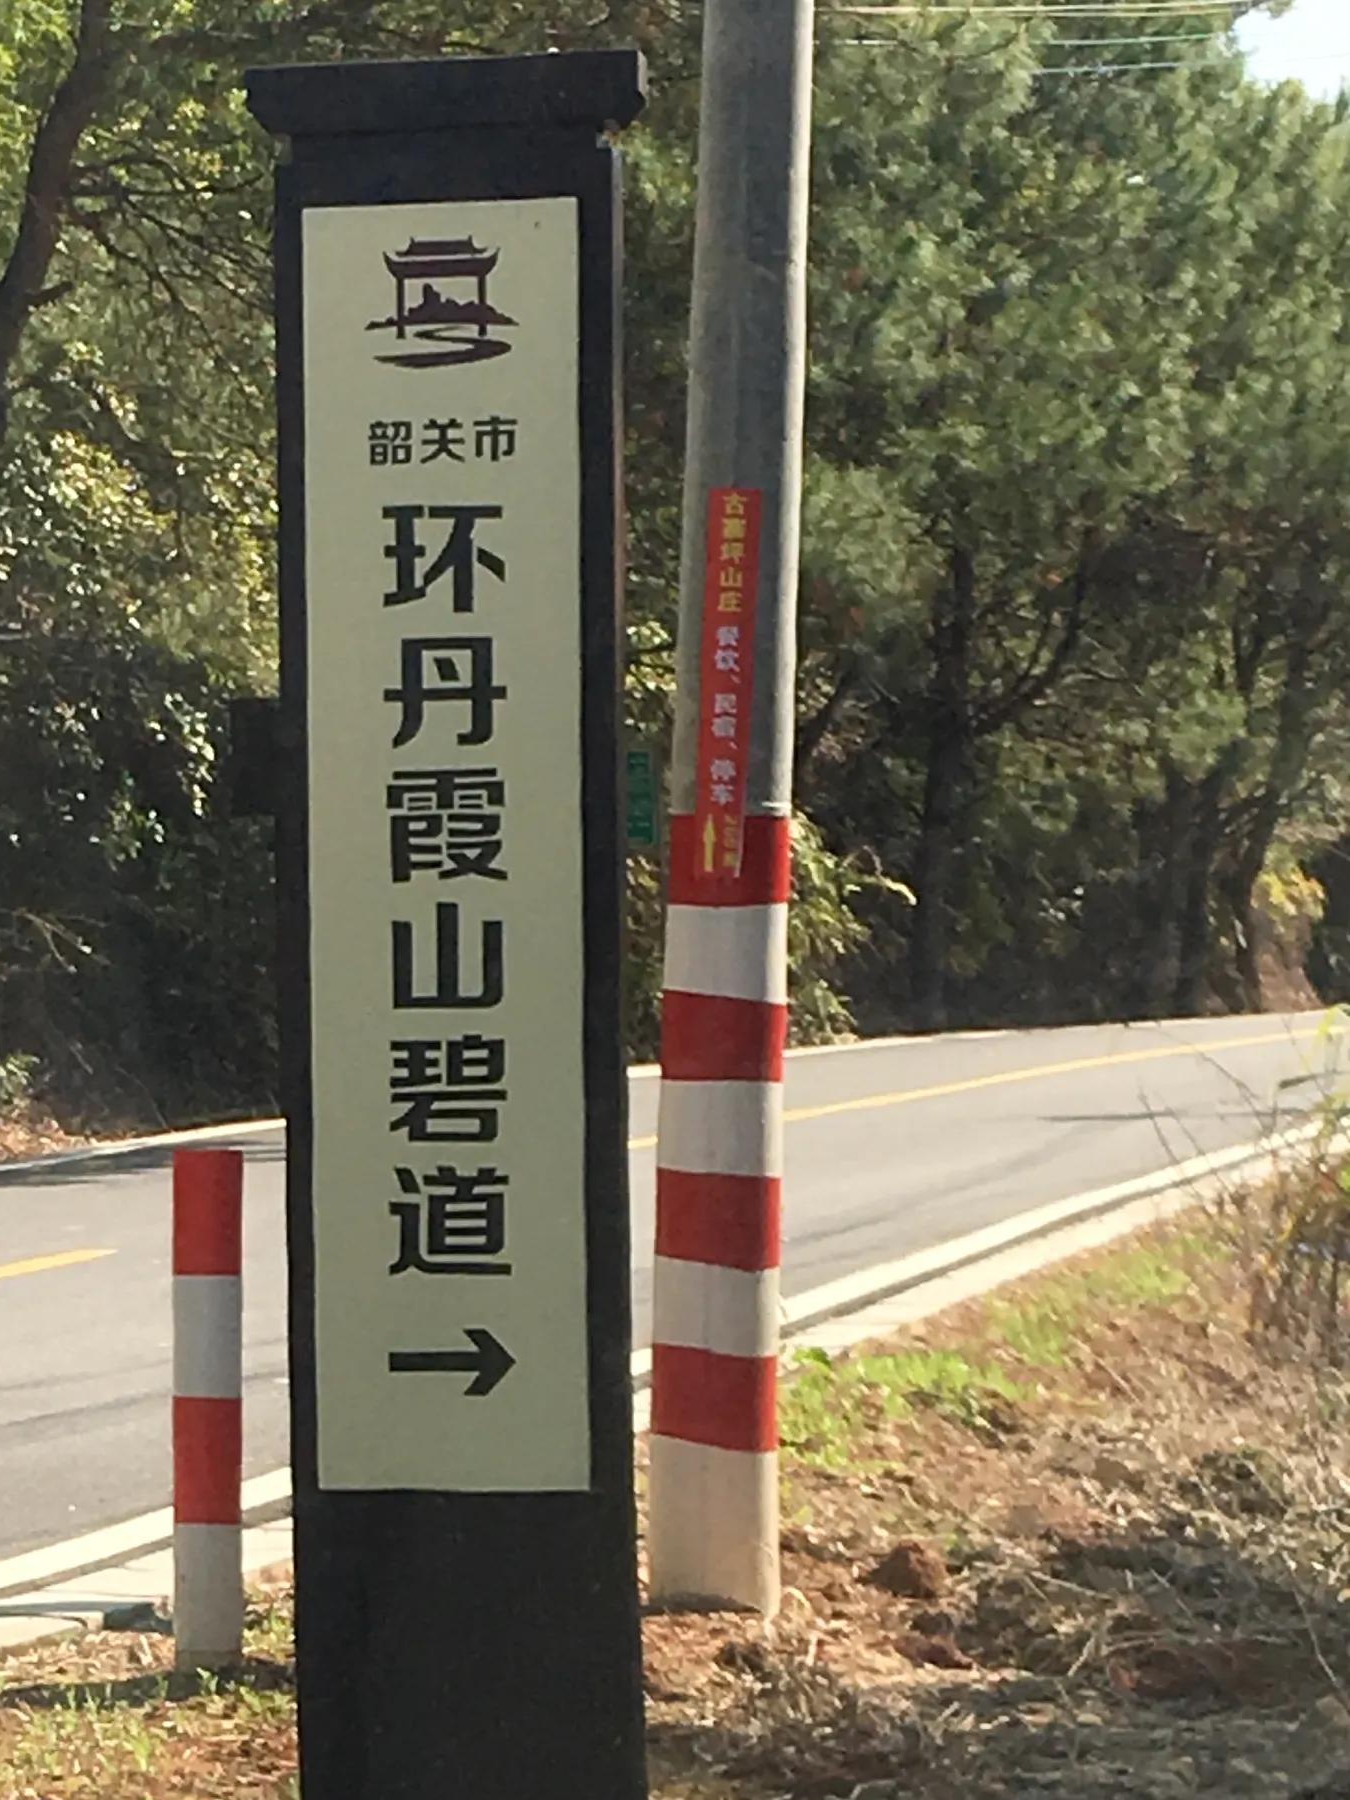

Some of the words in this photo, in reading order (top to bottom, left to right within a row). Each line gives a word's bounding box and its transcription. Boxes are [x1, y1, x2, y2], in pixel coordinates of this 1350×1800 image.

[367, 415, 519, 467] 韶关市
[382, 503, 513, 1277] 环丹霞山碧道
